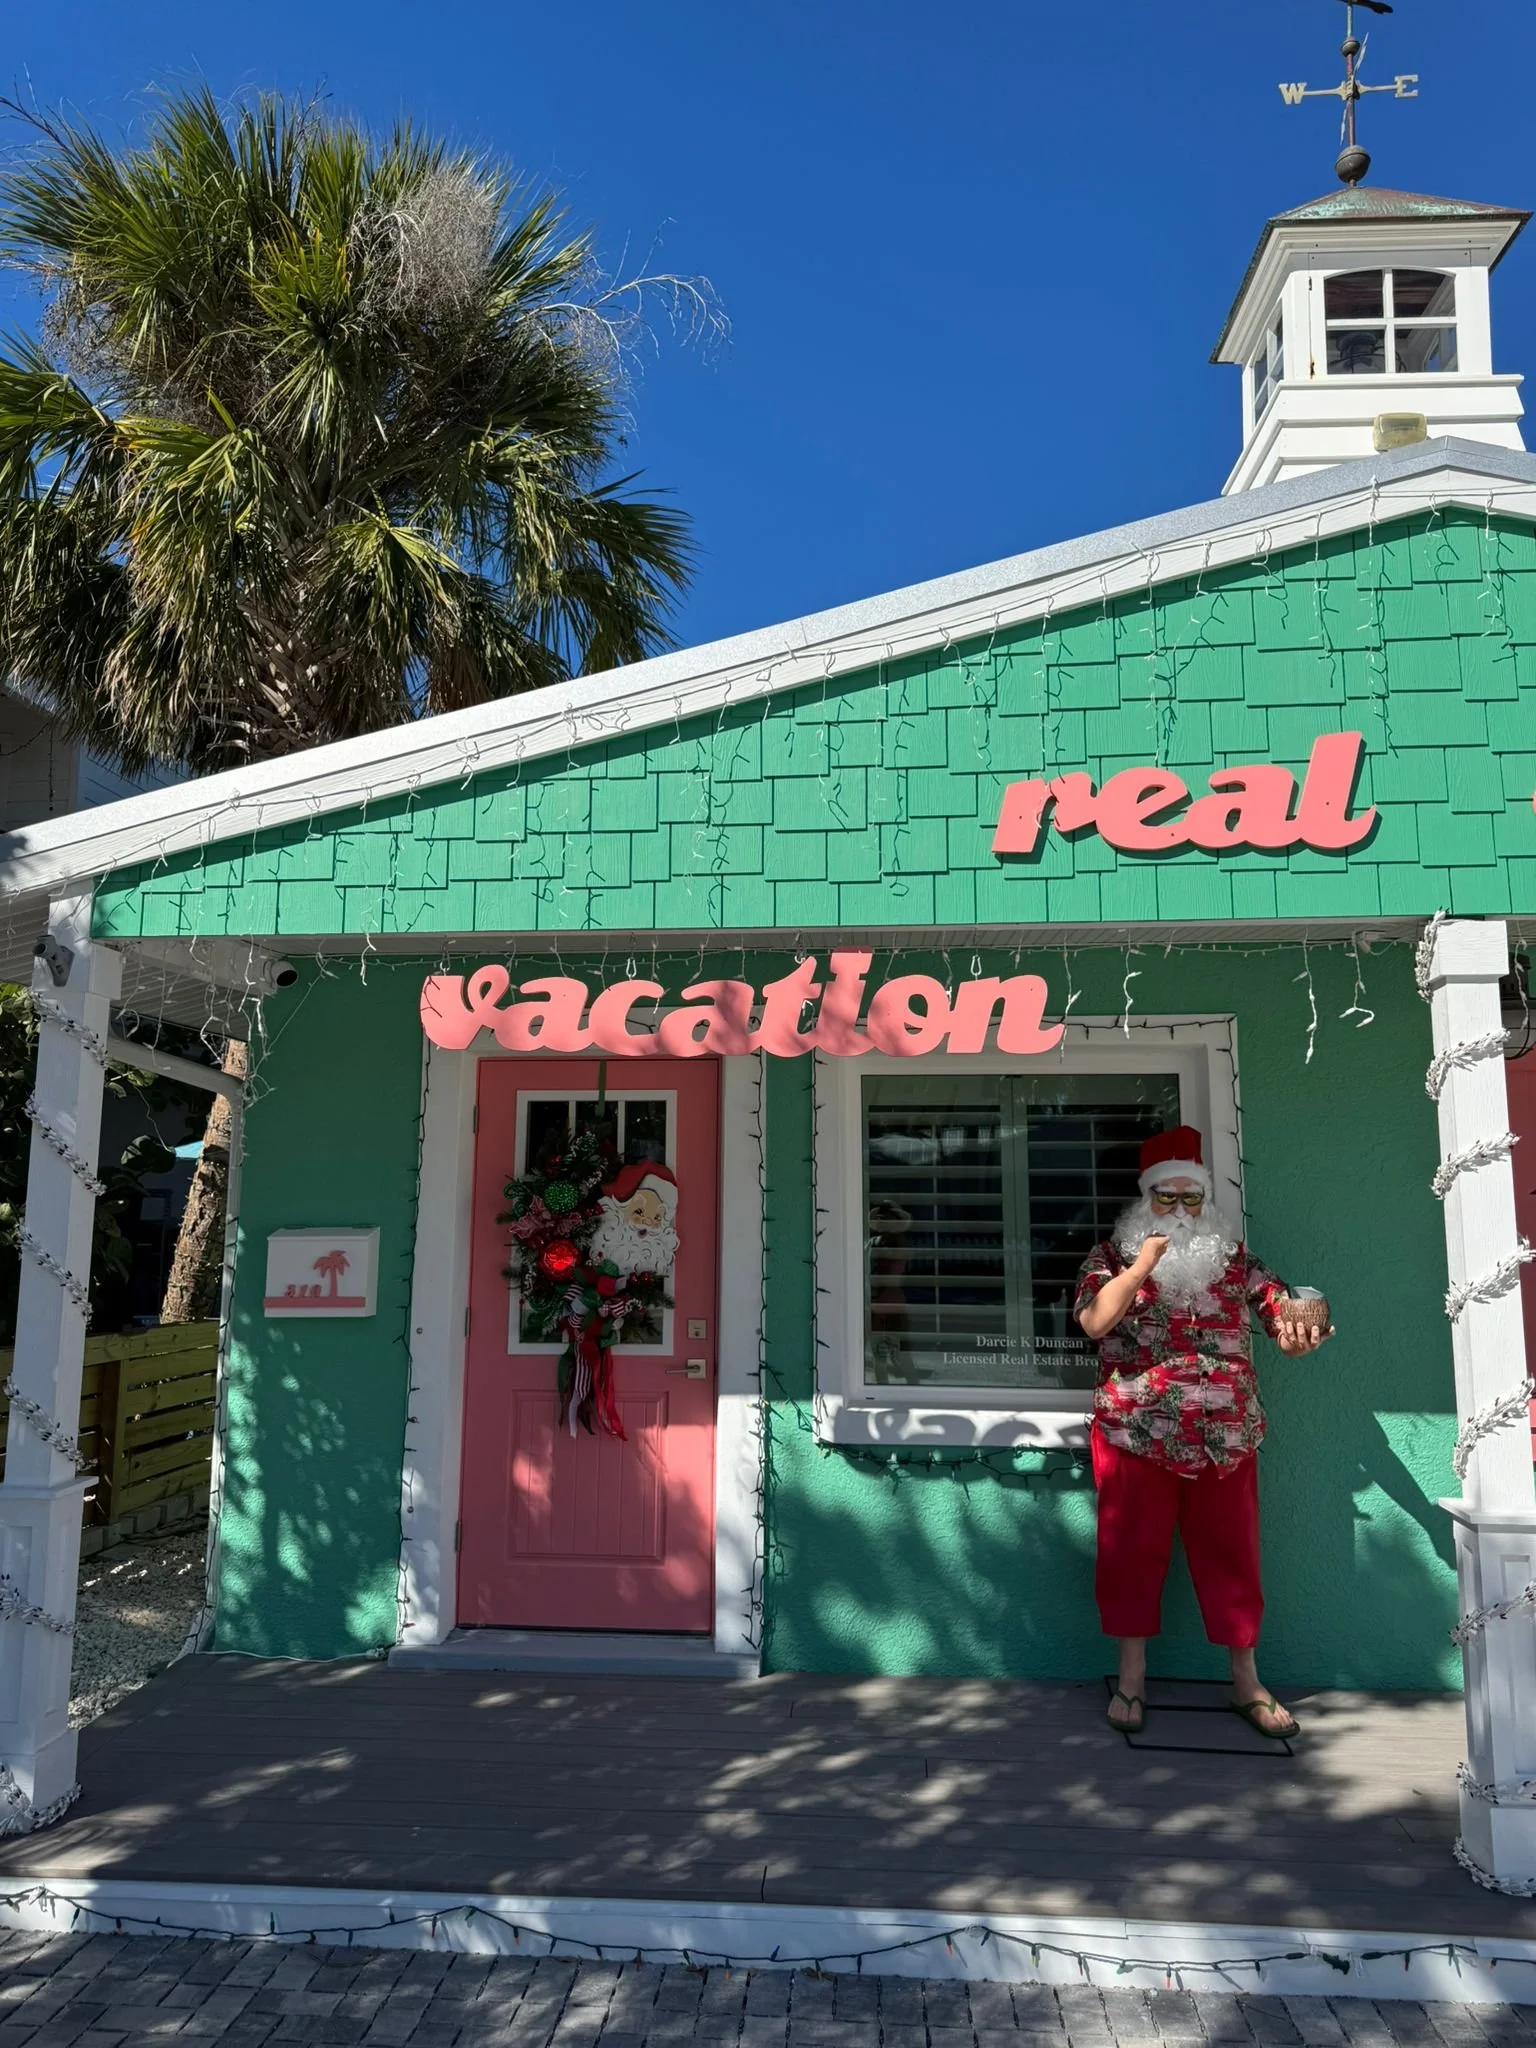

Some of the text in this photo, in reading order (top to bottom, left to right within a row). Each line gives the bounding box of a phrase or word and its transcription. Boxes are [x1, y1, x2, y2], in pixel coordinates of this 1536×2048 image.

[1279, 74, 1419, 105] W E
[991, 731, 1377, 854] real
[420, 945, 1065, 1058] vacation
[976, 1335, 1084, 1349] Darcie K Duncan
[943, 1352, 1099, 1367] Licensed Real Estate Bro
